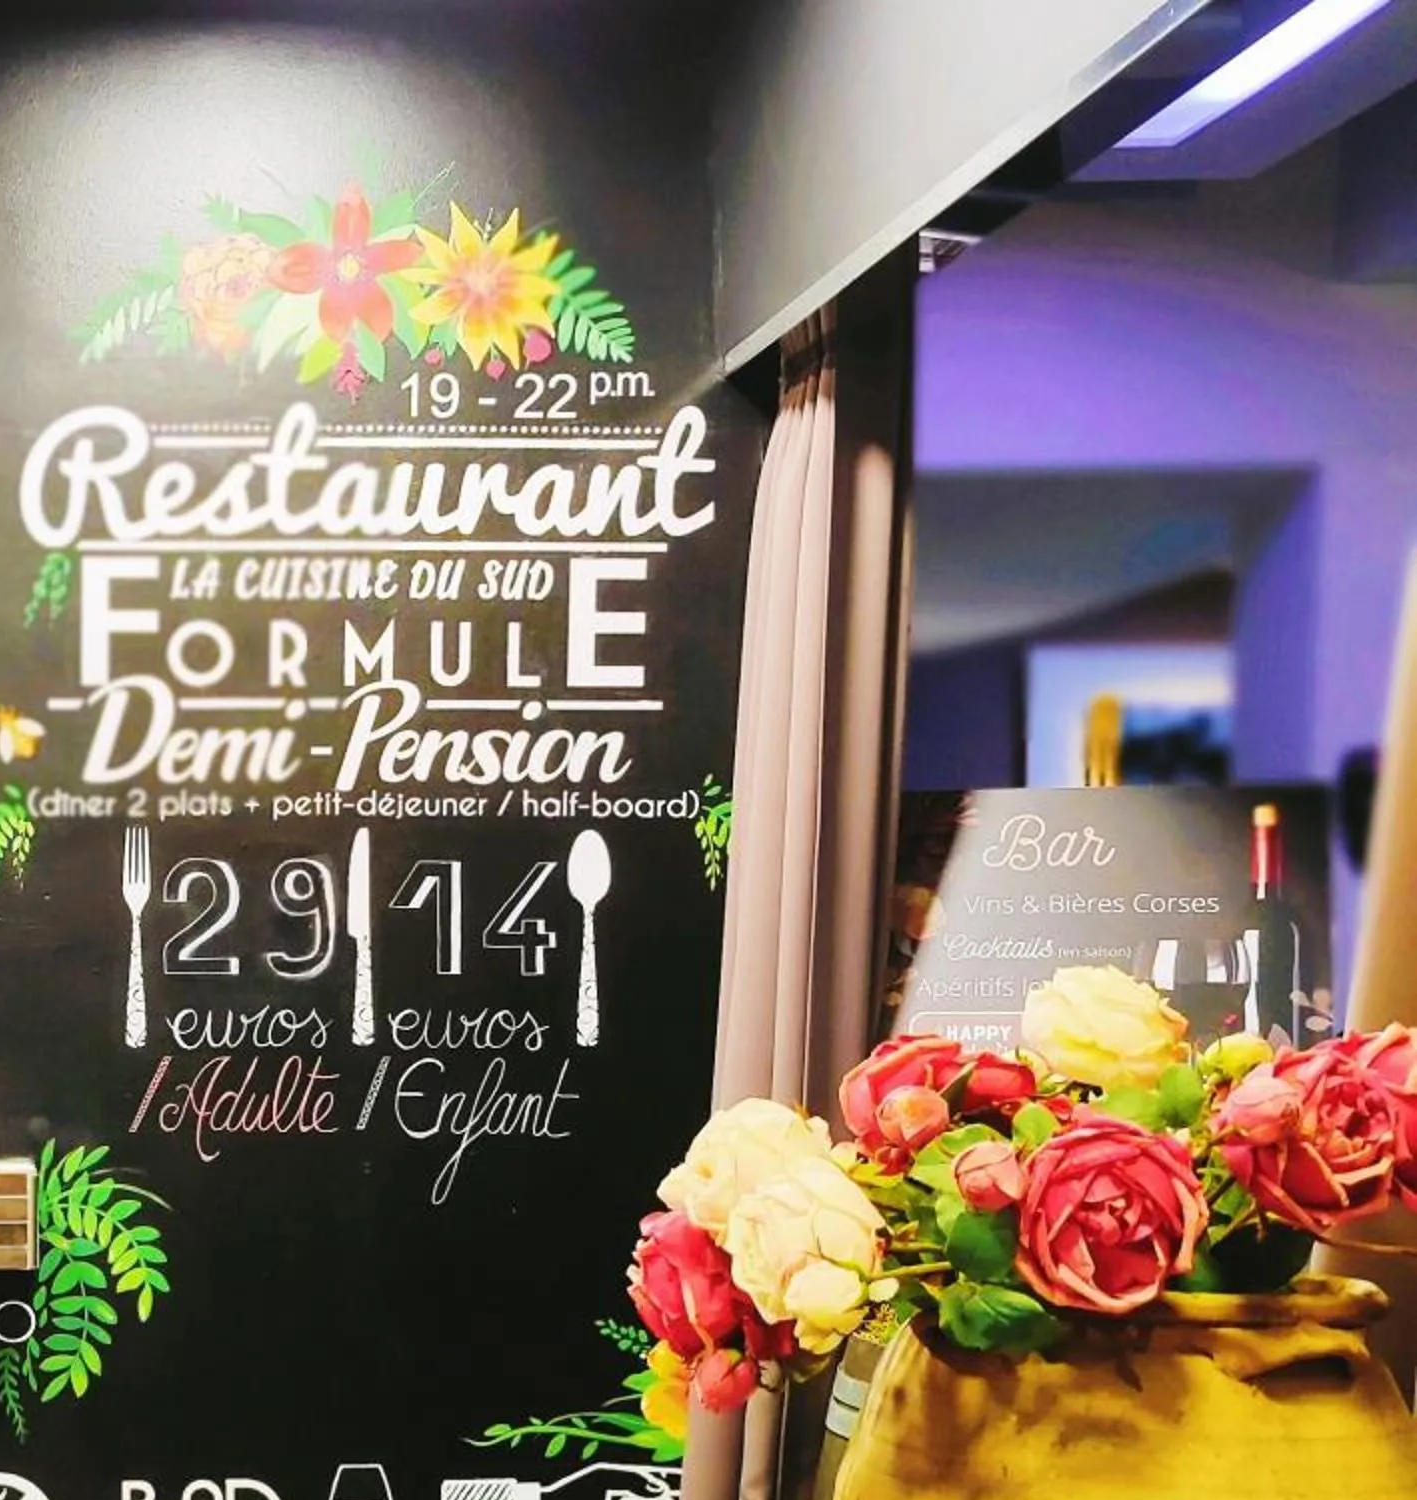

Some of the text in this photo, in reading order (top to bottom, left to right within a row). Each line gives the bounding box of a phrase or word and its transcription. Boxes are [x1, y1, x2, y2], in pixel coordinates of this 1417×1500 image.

[400, 372, 460, 419] 19
[513, 373, 578, 419] 22
[20, 402, 715, 547] Restaurant
[170, 557, 554, 601] LA CUISINE DU SUD
[80, 556, 649, 687] FORMULE
[127, 787, 148, 818] 2
[158, 789, 232, 822] plats
[271, 788, 488, 824] petit-déjeuner
[522, 789, 700, 819] half-board)
[982, 813, 1116, 872] Bar
[161, 857, 337, 979] 29
[388, 860, 558, 977] 14
[964, 891, 1221, 915] Vins & Bières Corses
[943, 933, 1054, 961] Cocktails
[915, 974, 1015, 1002] Apéritifs
[166, 1004, 327, 1051] euros
[388, 1008, 550, 1052] euros
[945, 1022, 1013, 1042] HAPPY
